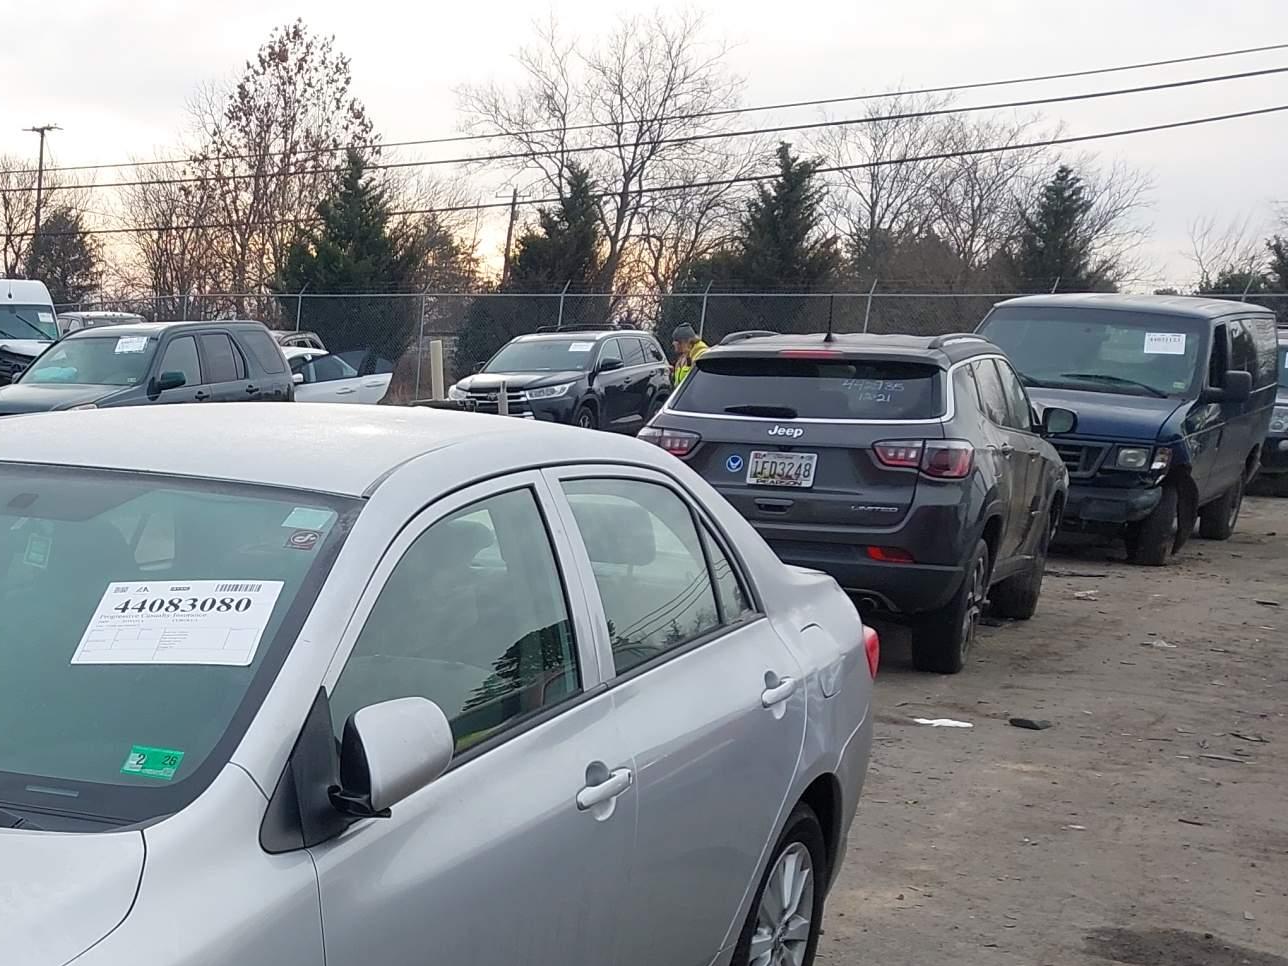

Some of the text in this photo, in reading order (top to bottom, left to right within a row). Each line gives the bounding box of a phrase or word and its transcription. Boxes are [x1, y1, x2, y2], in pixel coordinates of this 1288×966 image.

[768, 424, 804, 438] Jeep
[851, 505, 899, 513] LIMITED
[113, 597, 252, 614] 44083080
[135, 753, 146, 766] 2
